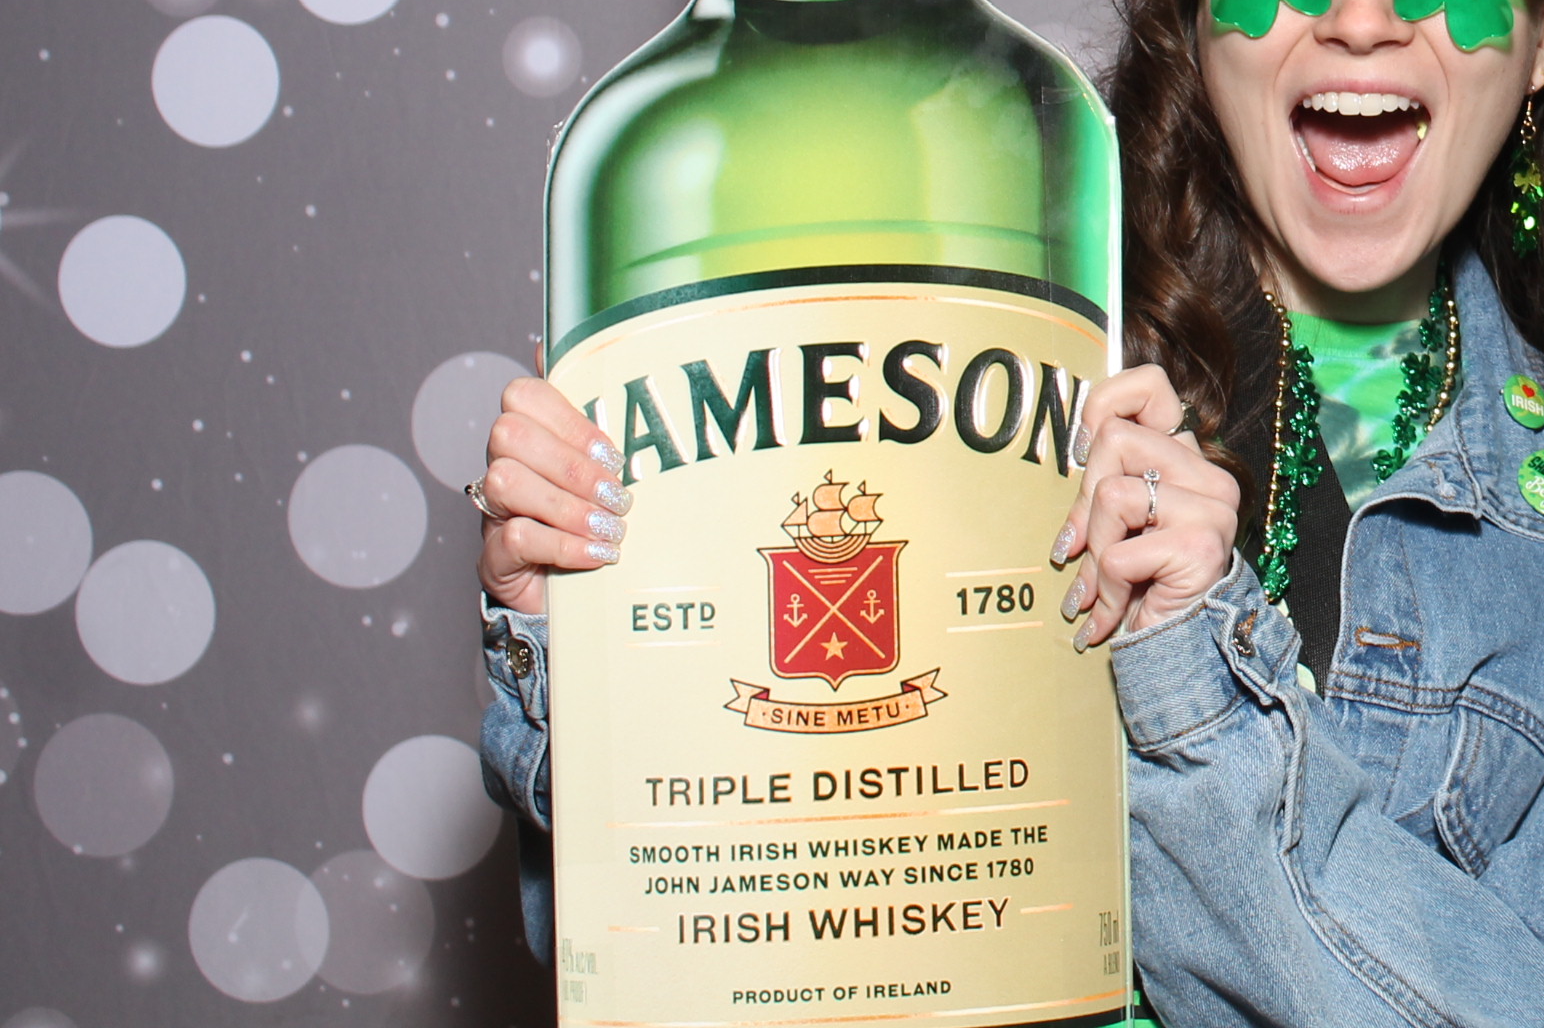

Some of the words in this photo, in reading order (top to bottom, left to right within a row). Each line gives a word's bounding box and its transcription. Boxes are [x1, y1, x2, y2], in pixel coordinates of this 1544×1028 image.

[1511, 394, 1544, 417] IRISH
[632, 601, 716, 632] ESTD
[956, 582, 1035, 617] 1780
[770, 707, 826, 727] SINE
[837, 702, 900, 726] METU
[645, 773, 792, 807] TRIPLE
[812, 758, 1029, 802] DISTILLED
[629, 844, 720, 864] SMOOTH
[730, 841, 798, 862] IRISH
[807, 833, 929, 859] WHISKEY
[937, 828, 1003, 852] MADE
[1010, 824, 1049, 846] THE
[644, 875, 701, 895] JOHN
[709, 871, 829, 894] JAMESON
[839, 867, 895, 889] WAY
[903, 861, 979, 885] SINCE
[986, 857, 1034, 879] 1780
[677, 910, 791, 945] IRISH
[807, 896, 1010, 941] WHISKEY
[732, 986, 826, 1005] PRODUCT
[832, 984, 859, 1002] OF
[865, 979, 953, 999] IRELAND
